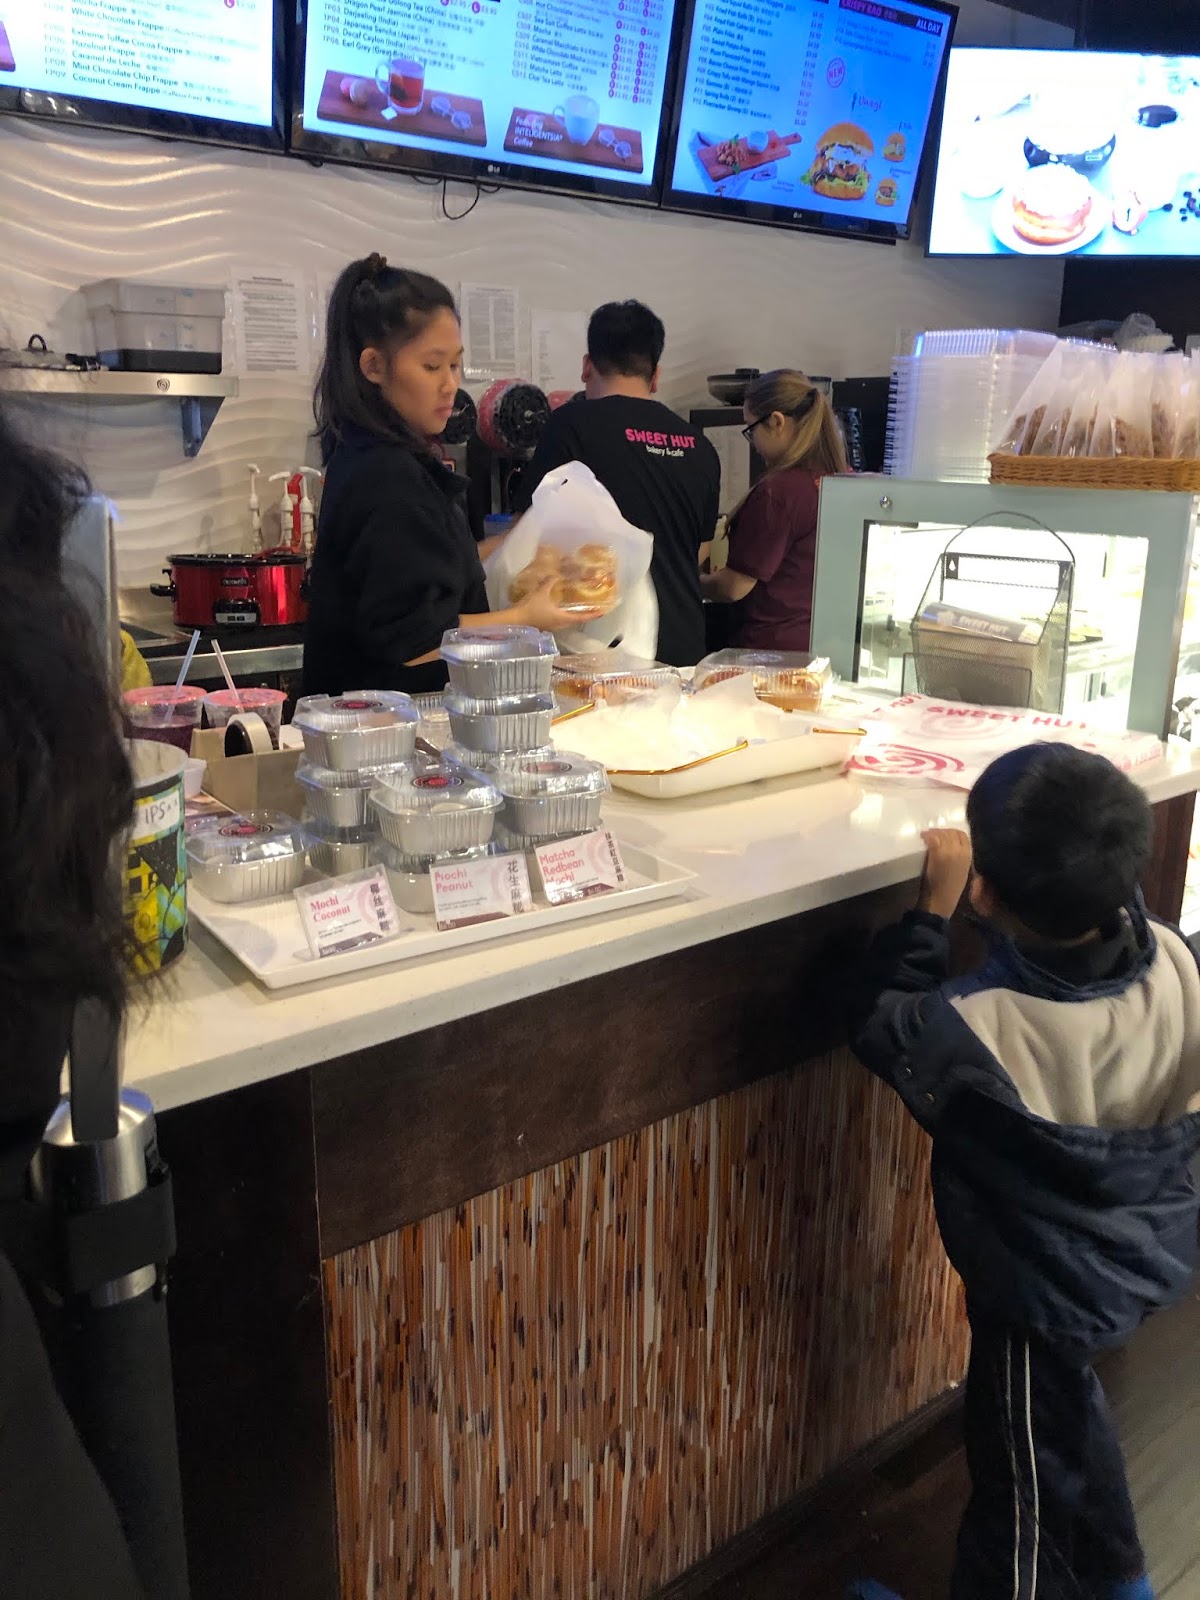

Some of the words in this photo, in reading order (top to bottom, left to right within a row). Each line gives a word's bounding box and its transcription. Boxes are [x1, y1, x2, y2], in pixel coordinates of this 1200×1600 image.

[72, 7, 95, 18] White
[97, 12, 136, 26] Chocolate
[138, 19, 164, 31] Frappe
[343, 7, 377, 23] Darjeeling
[916, 18, 928, 29] ALL
[927, 21, 942, 33] DAY
[342, 38, 355, 48] Earl
[356, 41, 371, 53] Grey
[72, 49, 105, 62] Caramel
[72, 60, 91, 71] Mint
[92, 64, 131, 79] Chocolate
[133, 71, 151, 83] Chip
[72, 72, 106, 86] Coconut
[107, 78, 133, 89] Cream
[134, 82, 161, 95] Frappe
[513, 137, 533, 148] Coffee
[625, 428, 668, 446] SWEET
[670, 434, 696, 449] HUT
[926, 705, 1025, 724] SWEET
[539, 849, 576, 865] Matcha
[434, 868, 467, 882] Mochi
[542, 859, 585, 876] Redbean
[435, 880, 474, 894] Peanut
[310, 895, 339, 912] Mochi
[313, 905, 351, 923] Coconut
